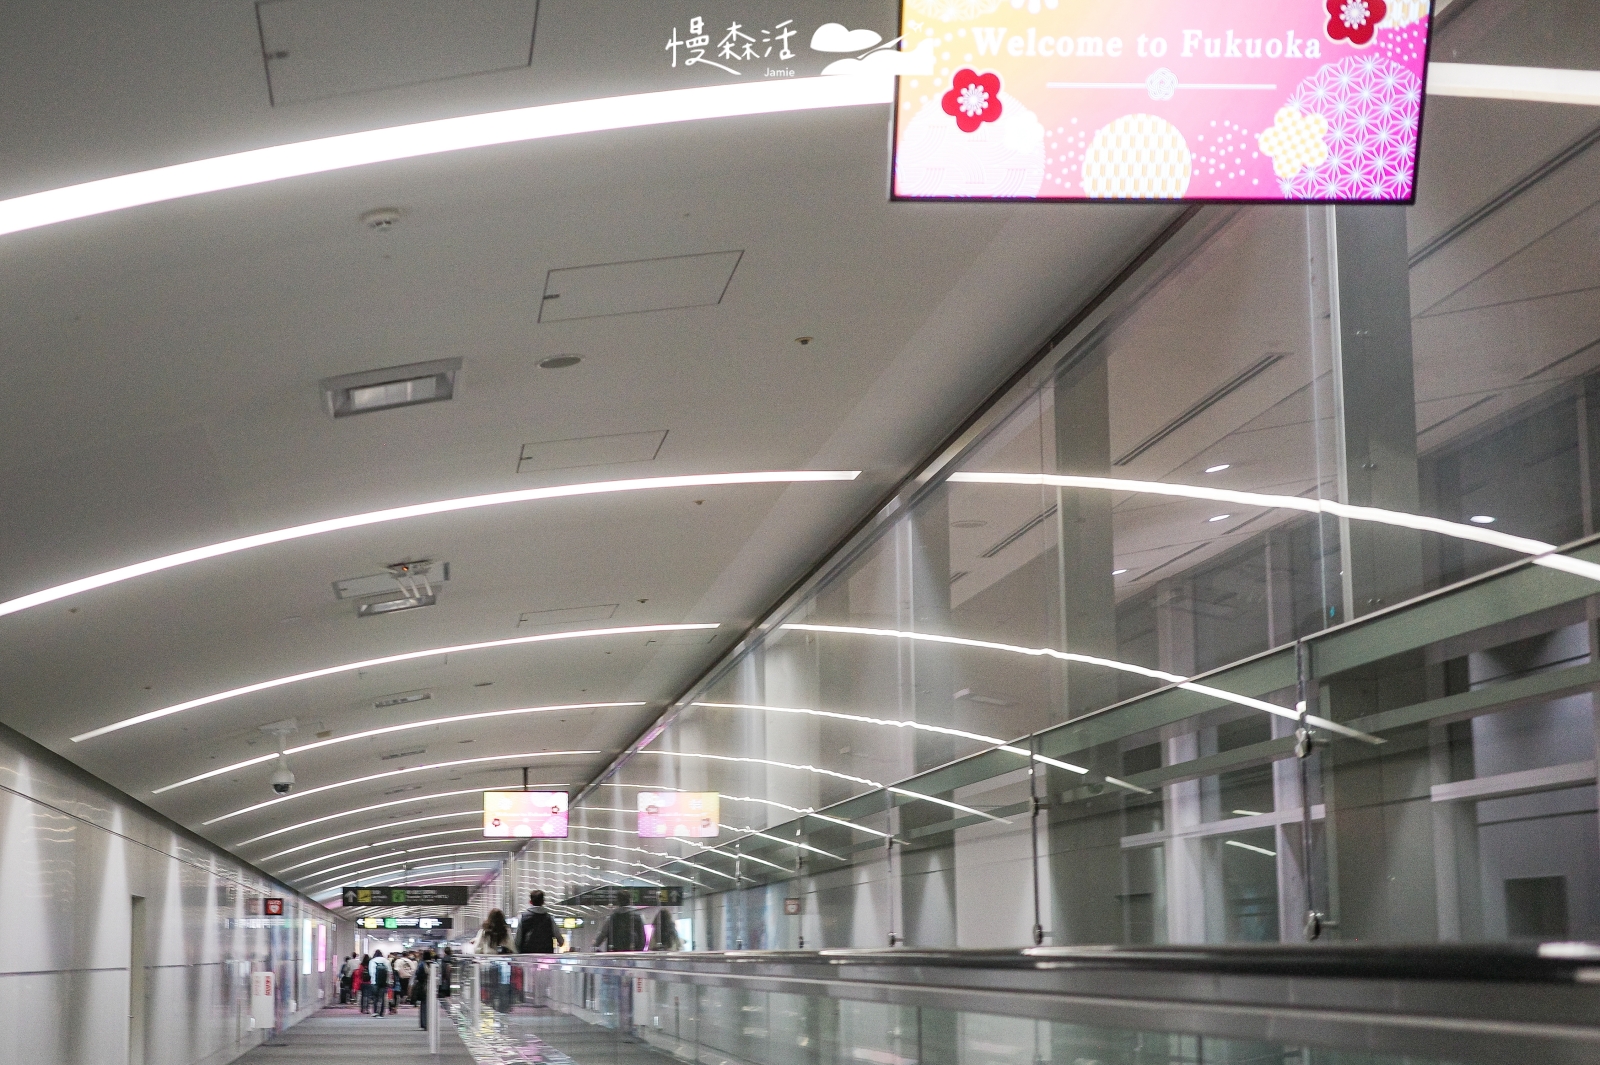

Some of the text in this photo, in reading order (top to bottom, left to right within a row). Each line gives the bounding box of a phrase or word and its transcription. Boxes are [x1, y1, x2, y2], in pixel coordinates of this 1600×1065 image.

[971, 26, 1322, 60] Welcome to Fukuoka
